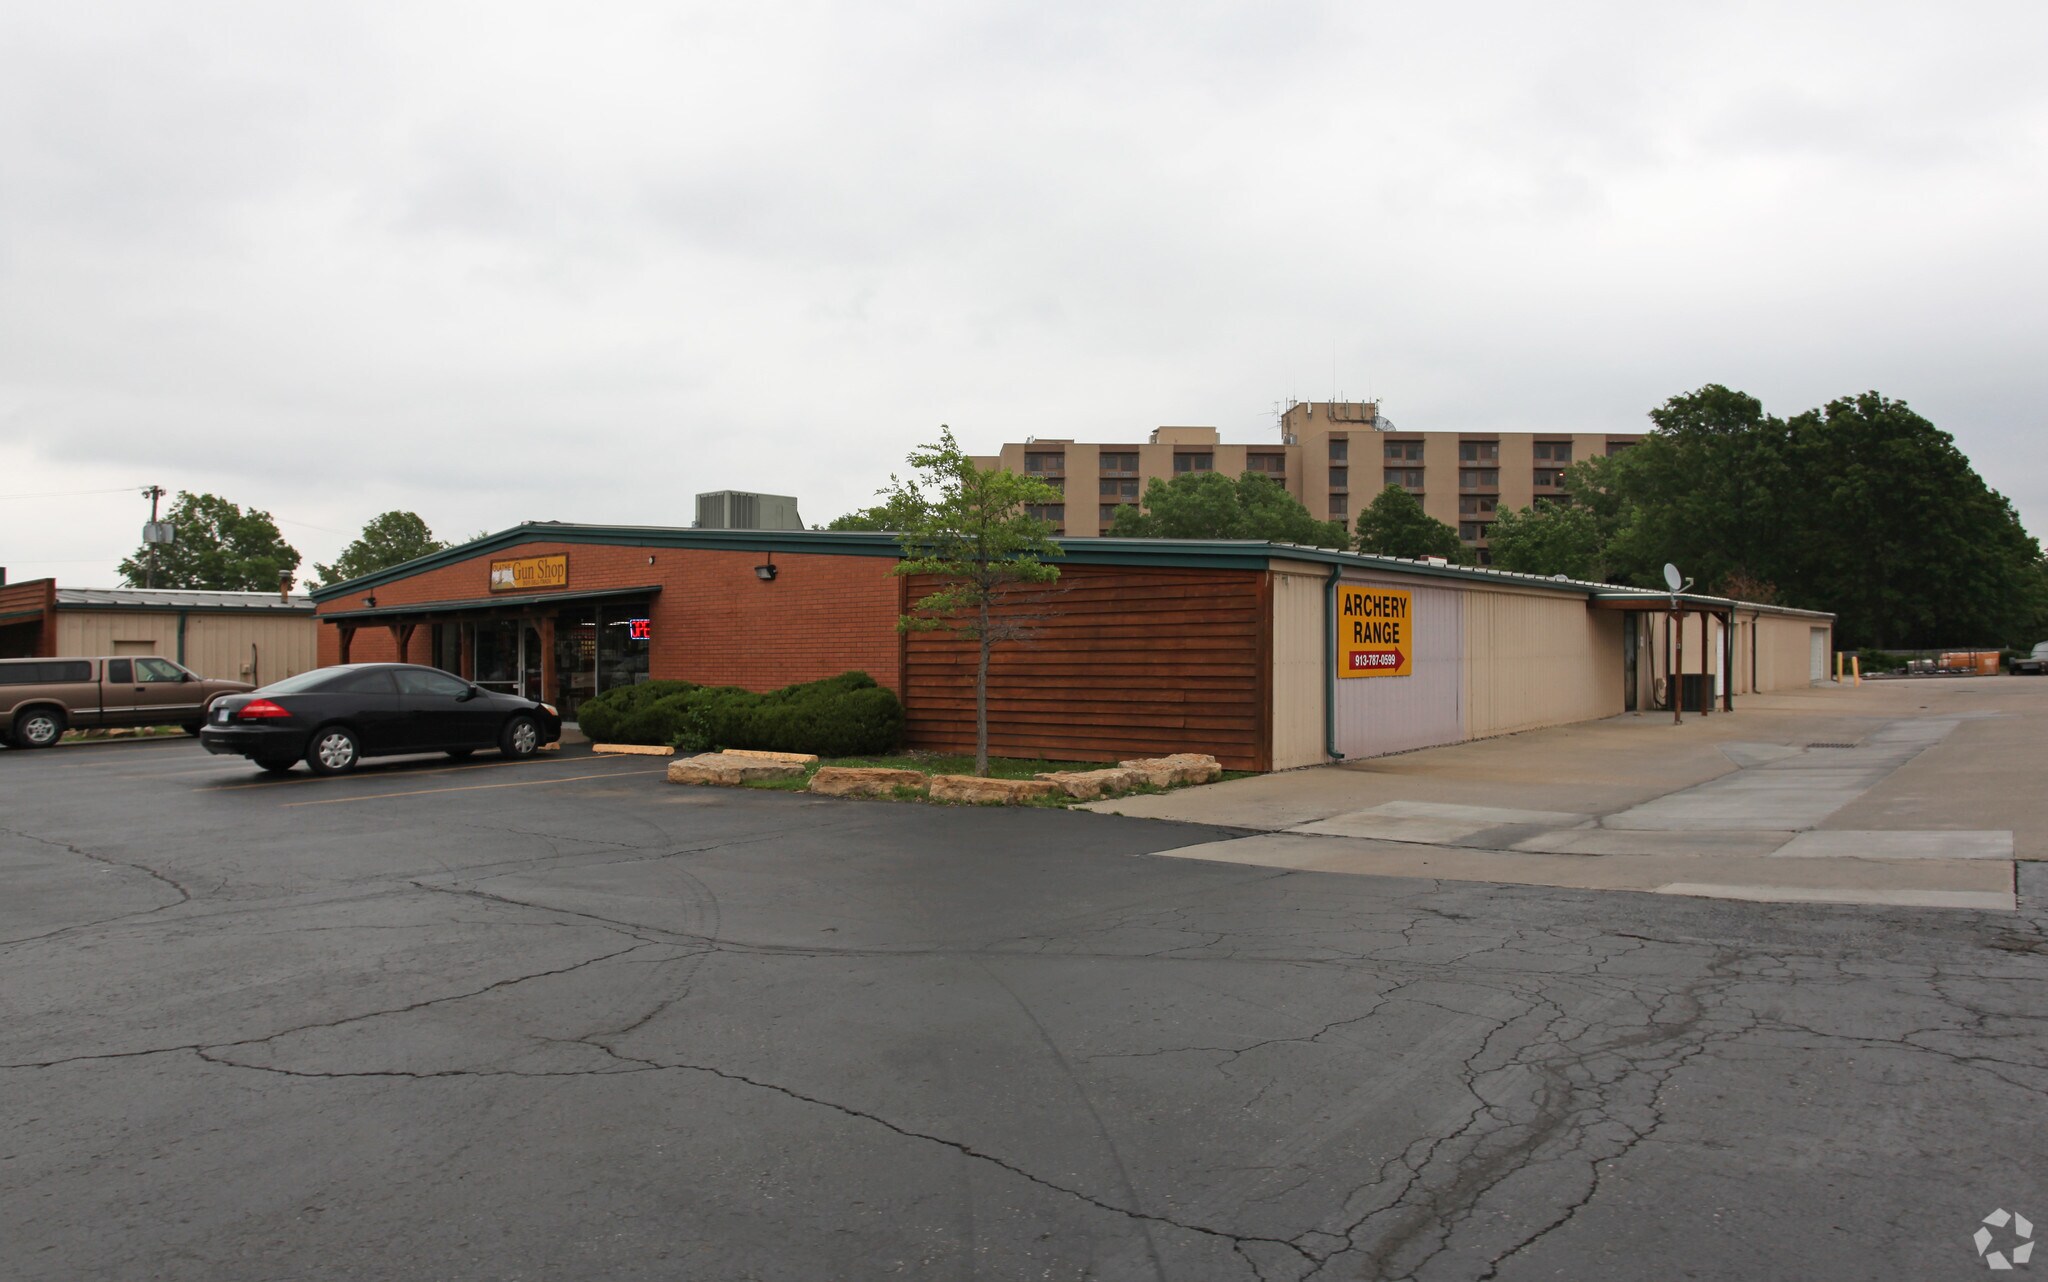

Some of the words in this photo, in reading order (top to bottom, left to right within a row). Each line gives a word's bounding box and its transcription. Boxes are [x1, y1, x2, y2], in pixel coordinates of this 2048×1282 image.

[513, 562, 534, 581] Gun
[537, 559, 564, 583] Shop
[1344, 593, 1407, 618] ARCHERY
[631, 621, 650, 637] OPE
[1354, 621, 1400, 644] RANGE
[1355, 654, 1396, 666] 913-787-0599
